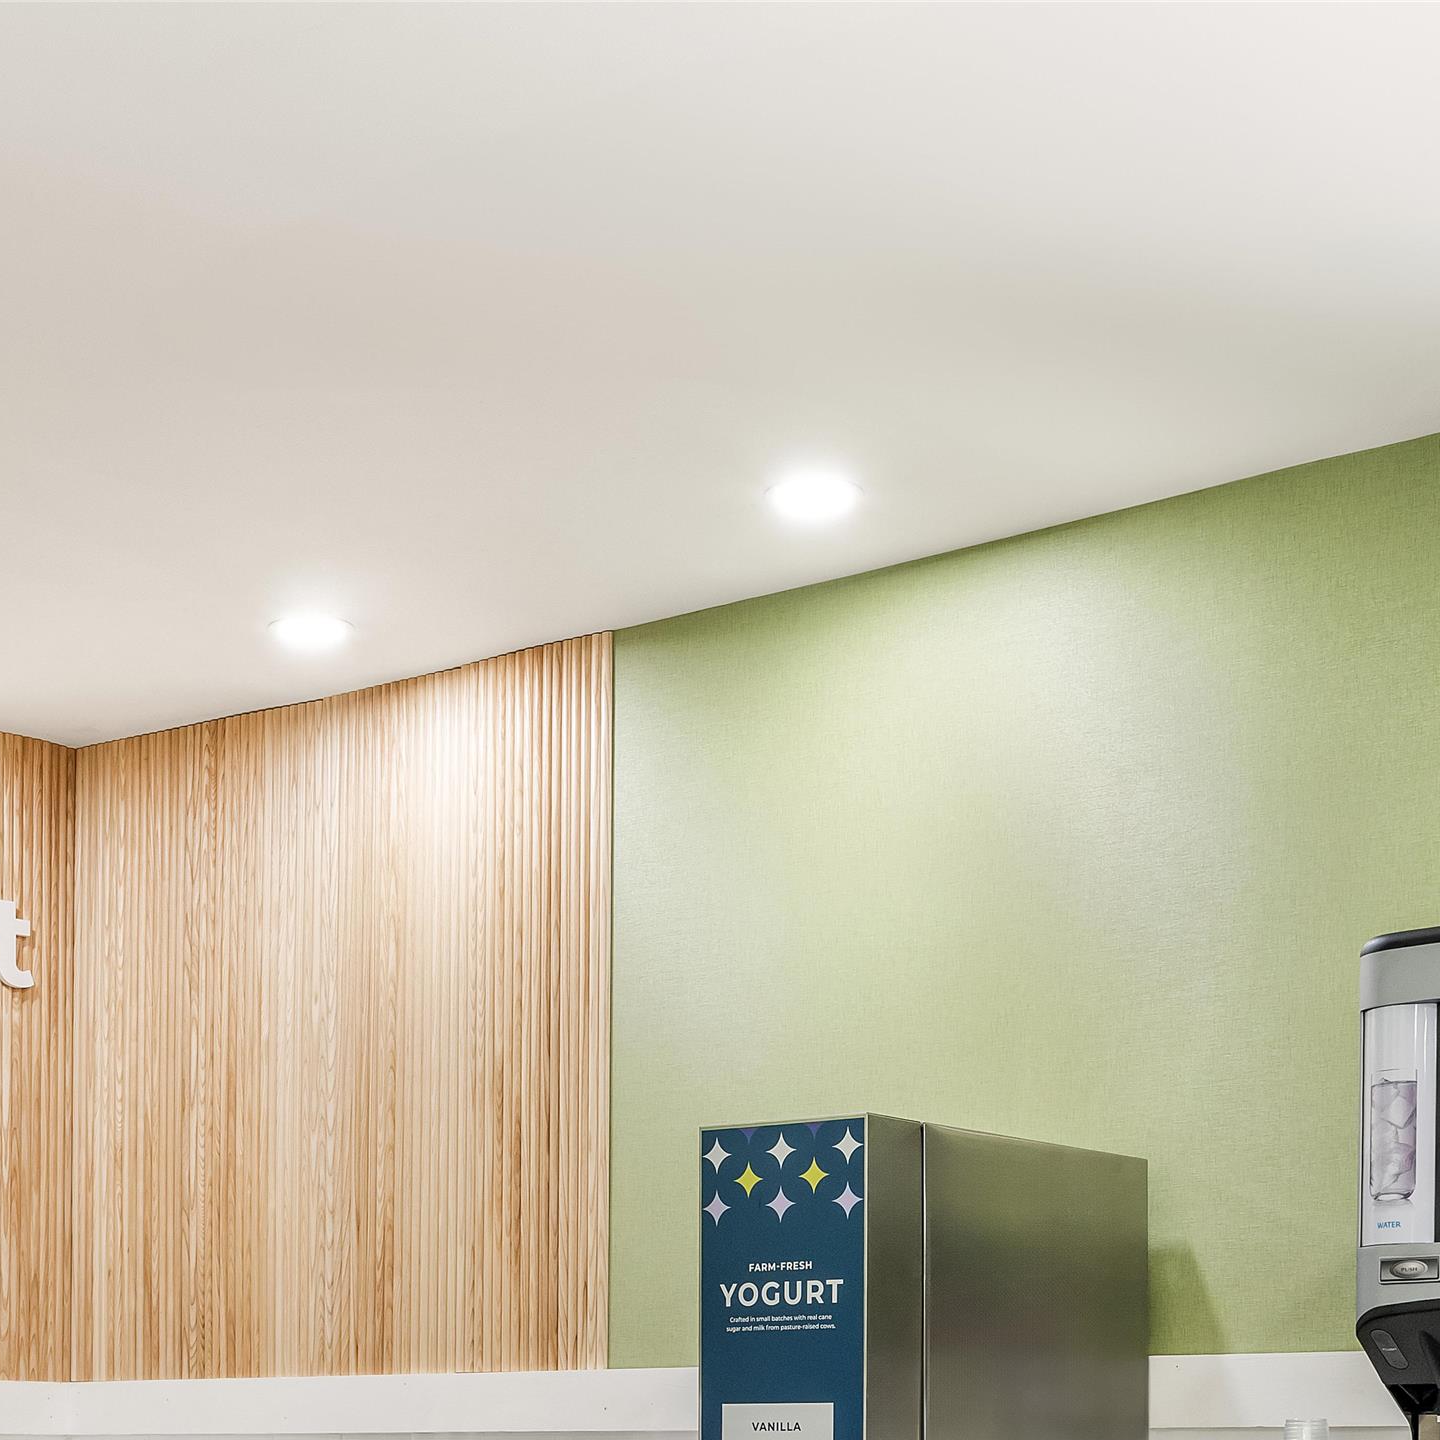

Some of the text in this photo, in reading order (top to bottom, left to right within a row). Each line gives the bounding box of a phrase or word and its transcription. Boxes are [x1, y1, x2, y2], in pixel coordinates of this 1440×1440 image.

[1376, 1221, 1402, 1229] WATER
[748, 1261, 813, 1272] FARM-FRESH
[720, 1279, 844, 1308] YOGURT
[780, 1323, 819, 1331] pasture-raised
[751, 1422, 802, 1432] VANILLA
